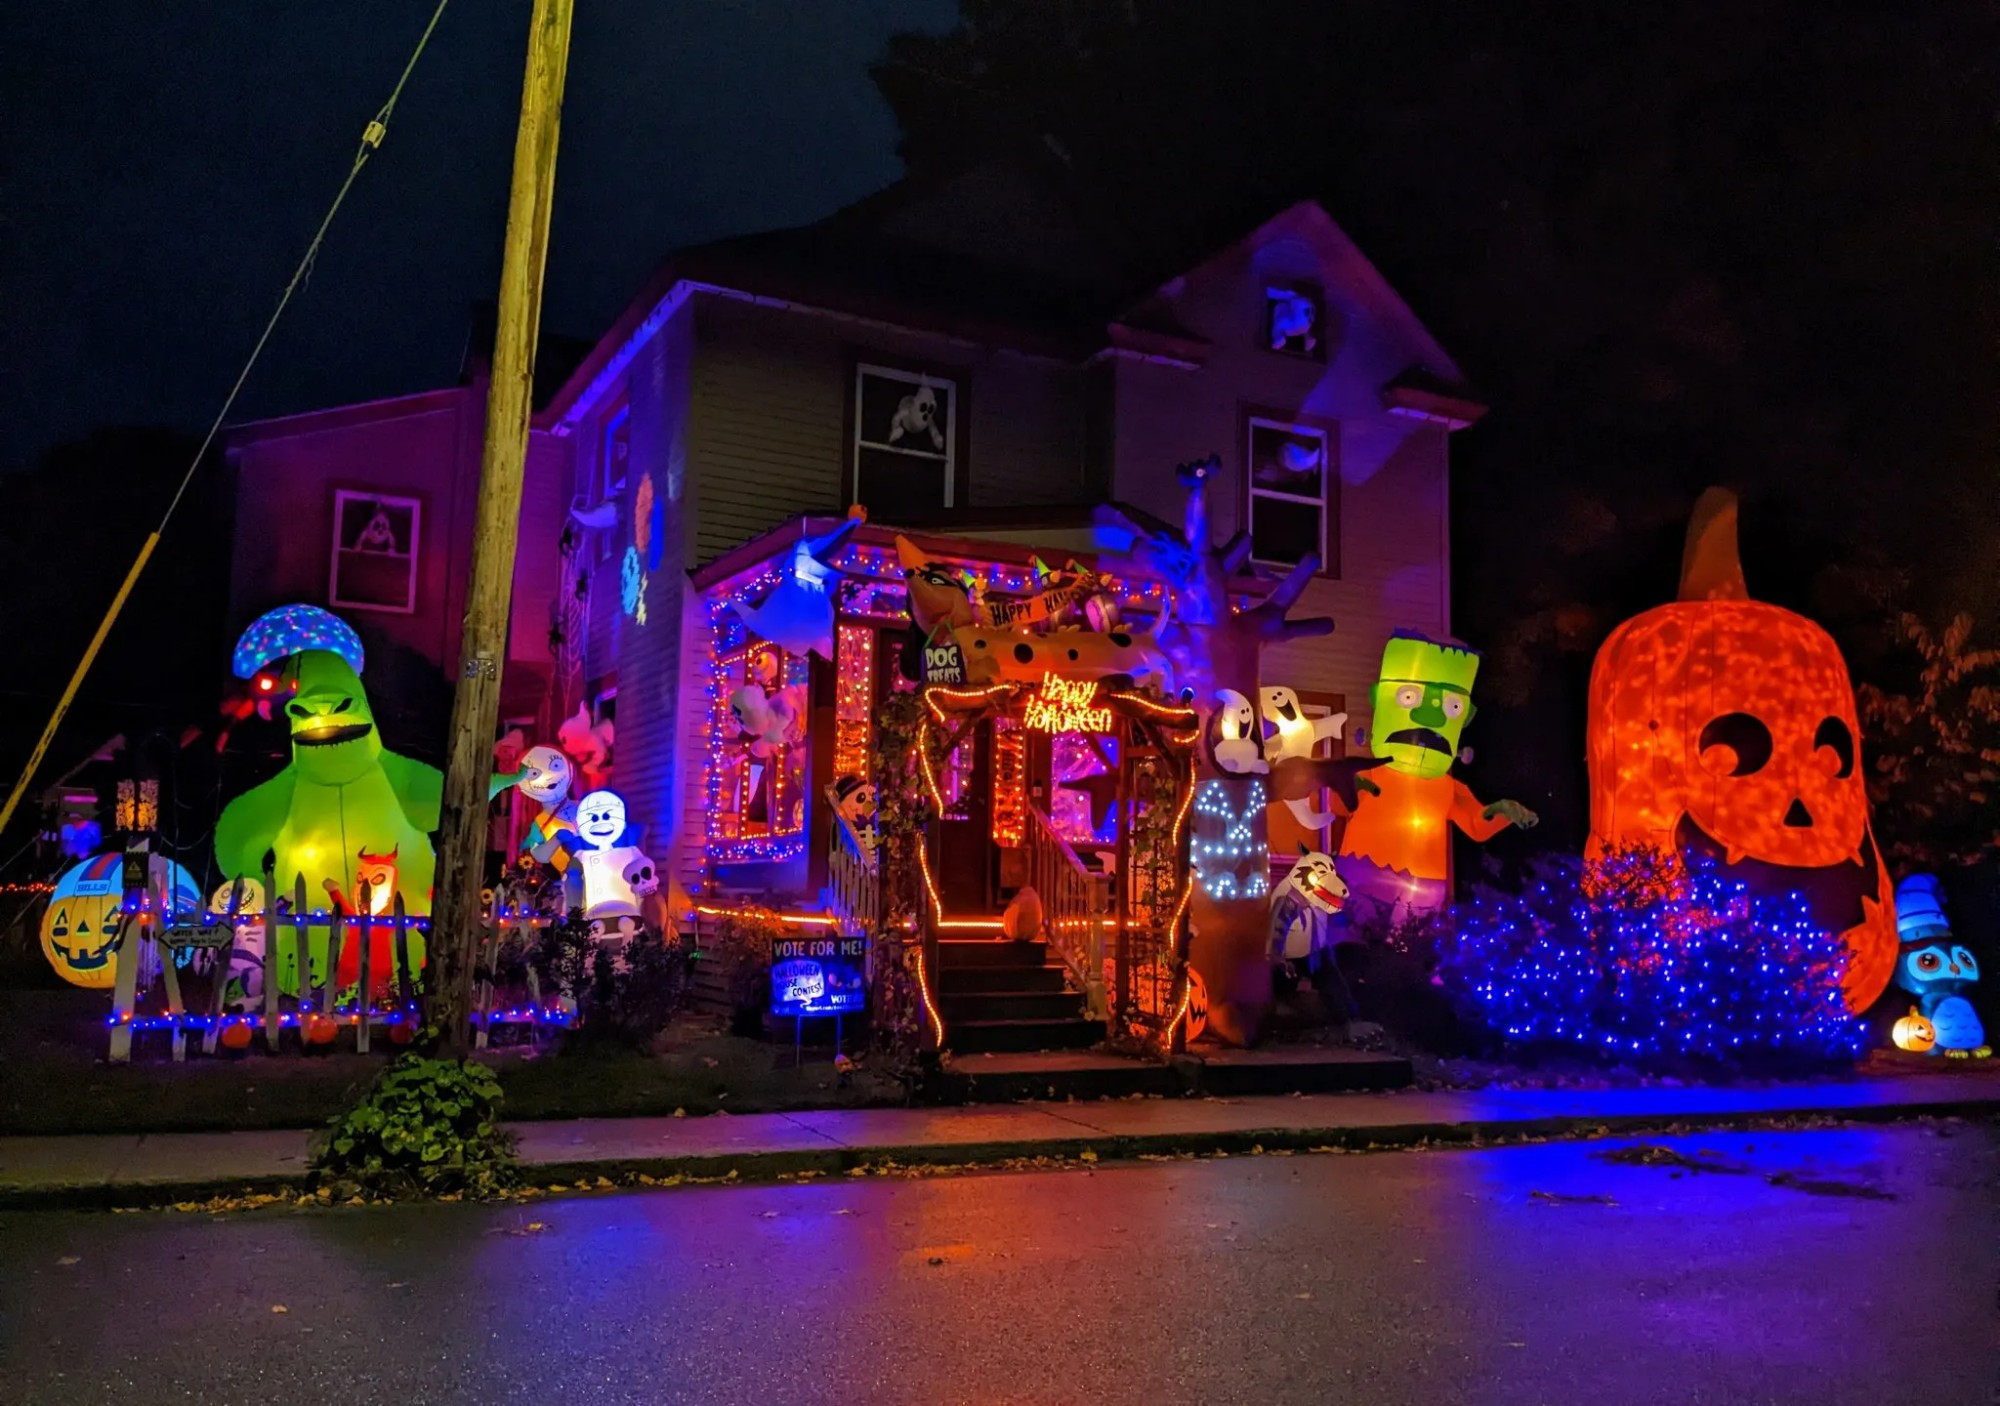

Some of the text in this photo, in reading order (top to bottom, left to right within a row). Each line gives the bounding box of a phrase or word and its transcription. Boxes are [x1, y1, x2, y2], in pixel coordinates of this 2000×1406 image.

[991, 601, 1032, 626] HAPPY
[925, 646, 958, 669] DOG
[927, 667, 961, 683] TREATS
[1041, 671, 1098, 710] Happy
[1024, 694, 1112, 735] Halloween
[77, 883, 108, 891] BILLS
[774, 940, 862, 957] VOTE FOR ME!
[775, 964, 819, 977] HALLOWEEN
[792, 982, 823, 997] CONTEST
